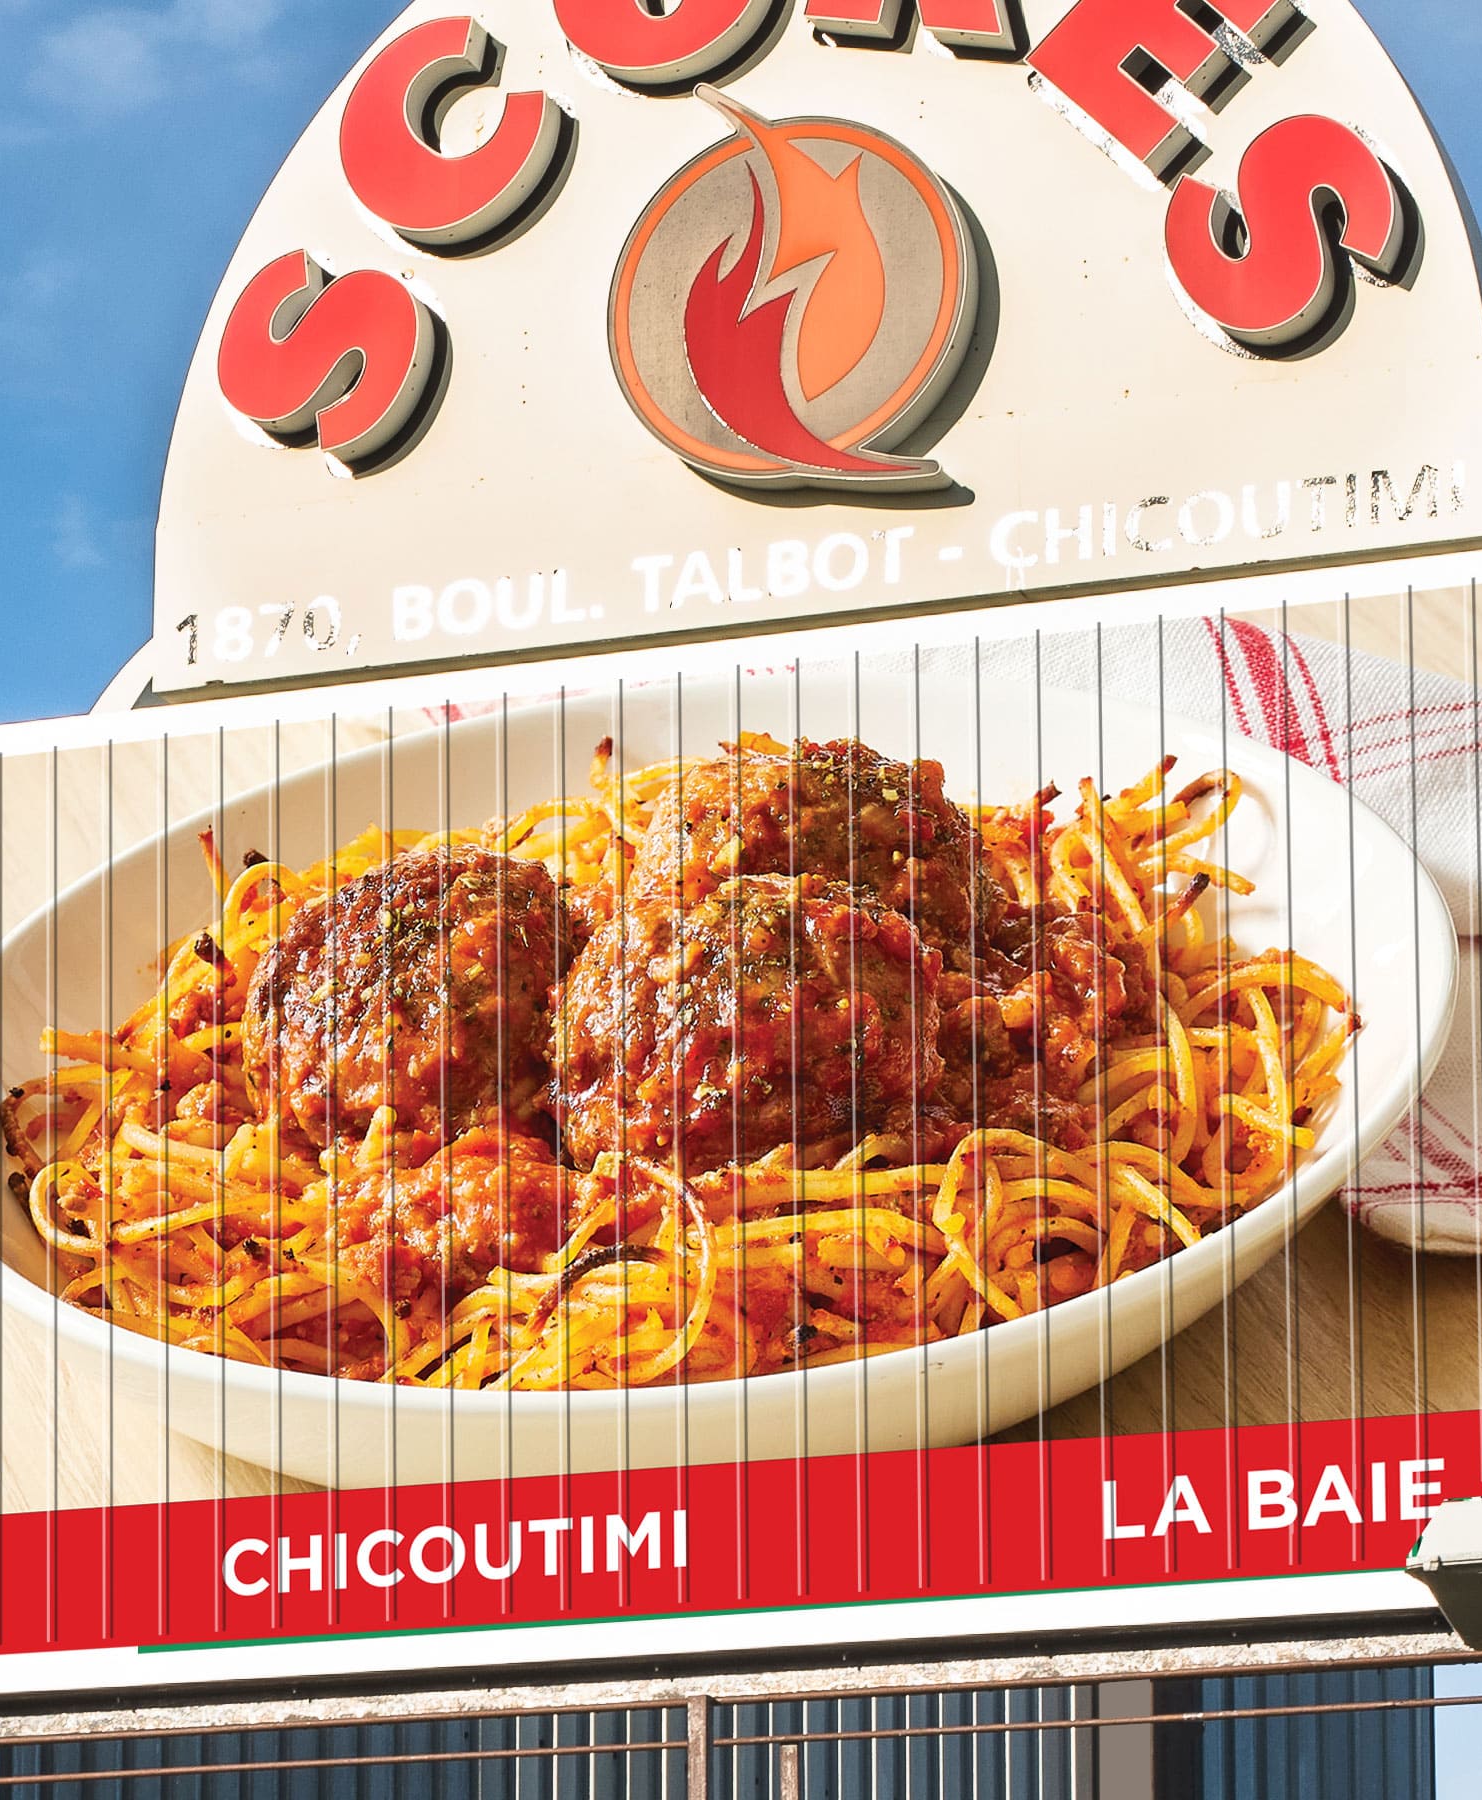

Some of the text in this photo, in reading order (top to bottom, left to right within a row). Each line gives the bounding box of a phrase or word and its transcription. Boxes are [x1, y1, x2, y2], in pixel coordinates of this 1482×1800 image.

[176, 595, 361, 666] 1870,
[392, 568, 605, 641] BOUL.
[630, 526, 915, 613] TALBOT
[989, 460, 1466, 567] CHICOUTIMI
[1102, 1458, 1445, 1540] LA BAIE
[221, 1509, 690, 1597] CHICOUTIMI
